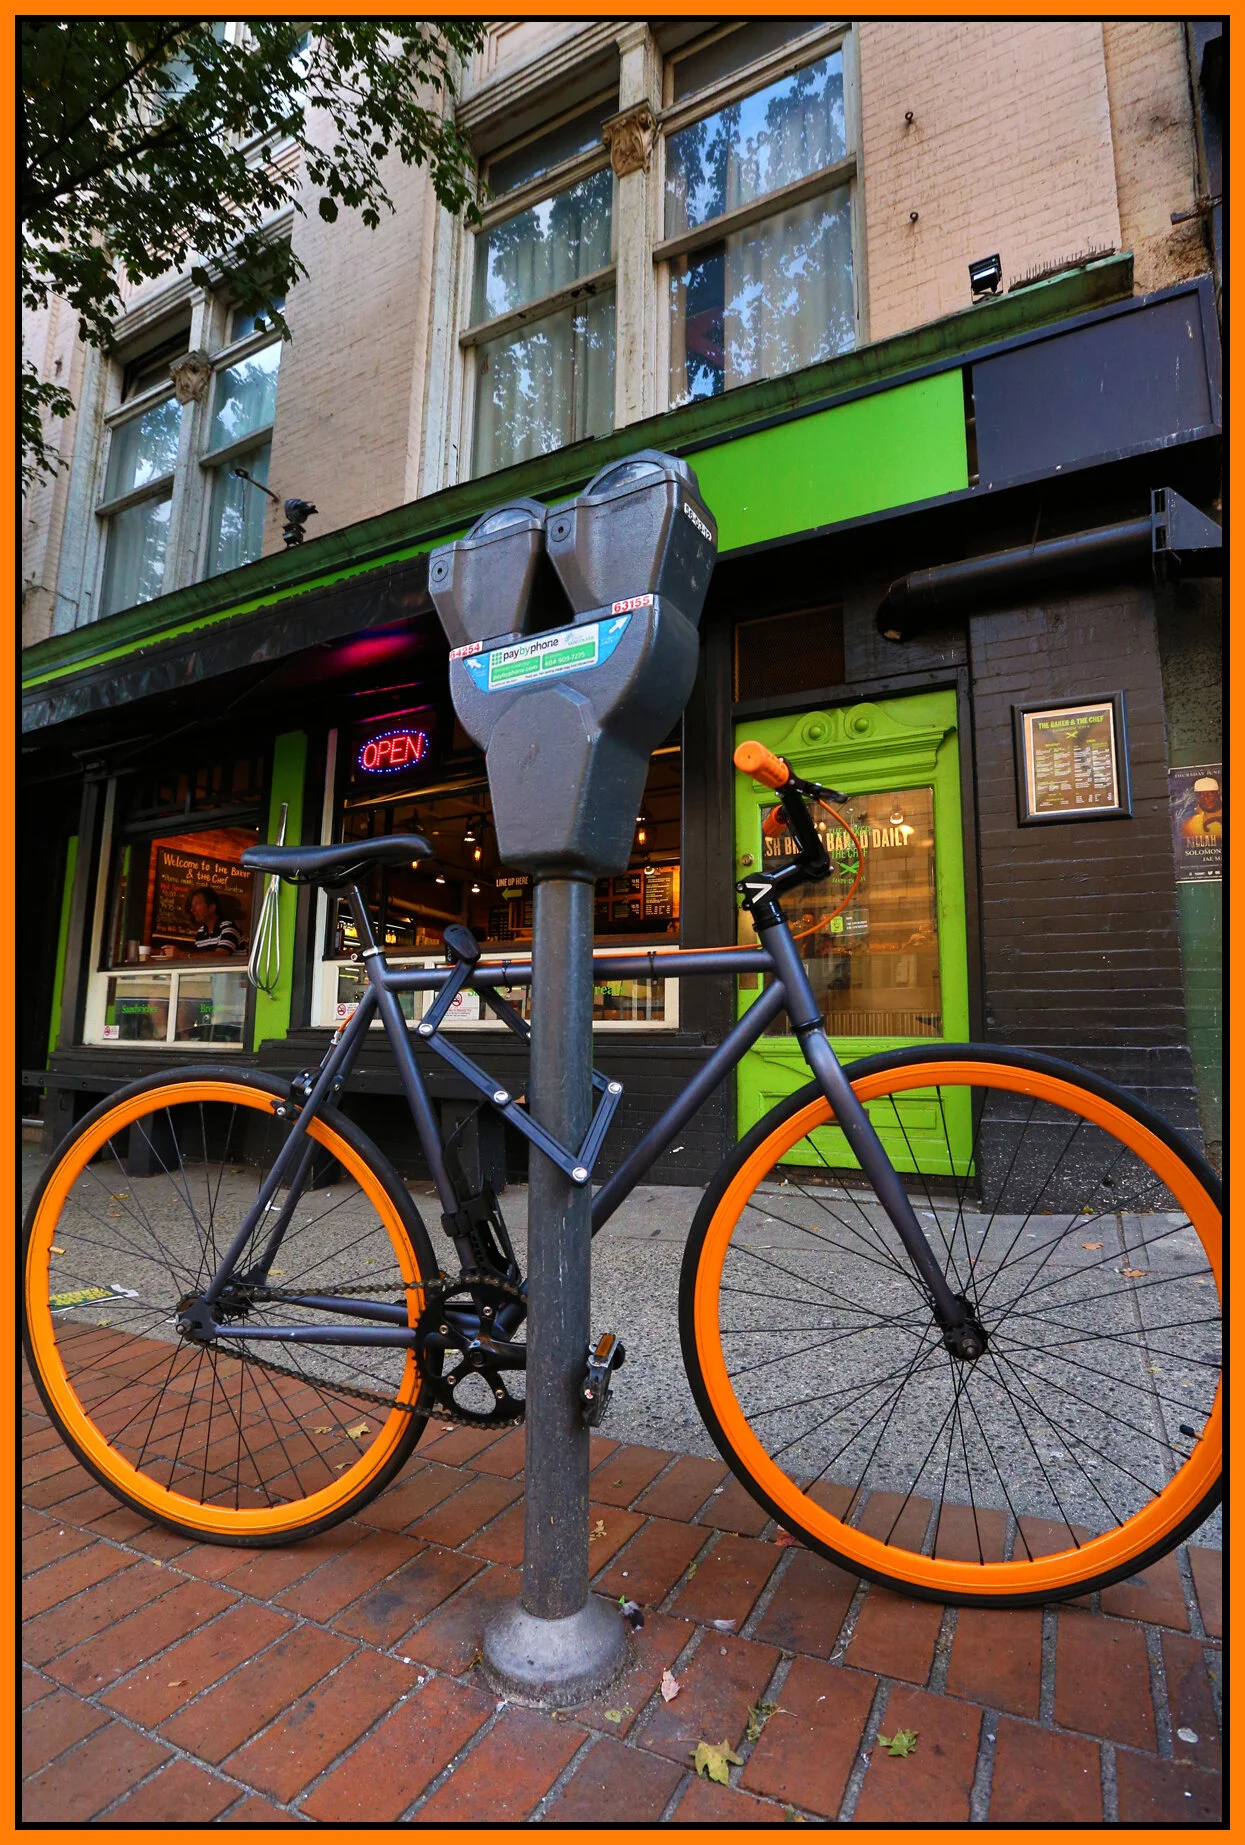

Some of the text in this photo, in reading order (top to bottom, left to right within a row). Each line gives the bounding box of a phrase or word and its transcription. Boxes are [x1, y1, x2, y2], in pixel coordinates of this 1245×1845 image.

[613, 596, 650, 613] 63155
[450, 643, 481, 660] 64254
[503, 638, 559, 661] paybyphone
[1038, 722, 1049, 730] THE
[1050, 720, 1069, 728] BAKER
[1076, 717, 1088, 725] THE
[1088, 715, 1104, 723] CHEF
[363, 733, 422, 767] OPEN
[826, 830, 868, 852] BAKD
[872, 827, 909, 848] DAILY
[847, 847, 867, 858] CHF
[1185, 848, 1221, 857] SOLOMON
[163, 853, 199, 869] Welcome
[201, 860, 210, 871] to
[186, 869, 194, 879] &
[496, 876, 528, 887] LINE UP HERE
[593, 984, 626, 996] reats
[121, 1004, 158, 1014] Sandwiches
